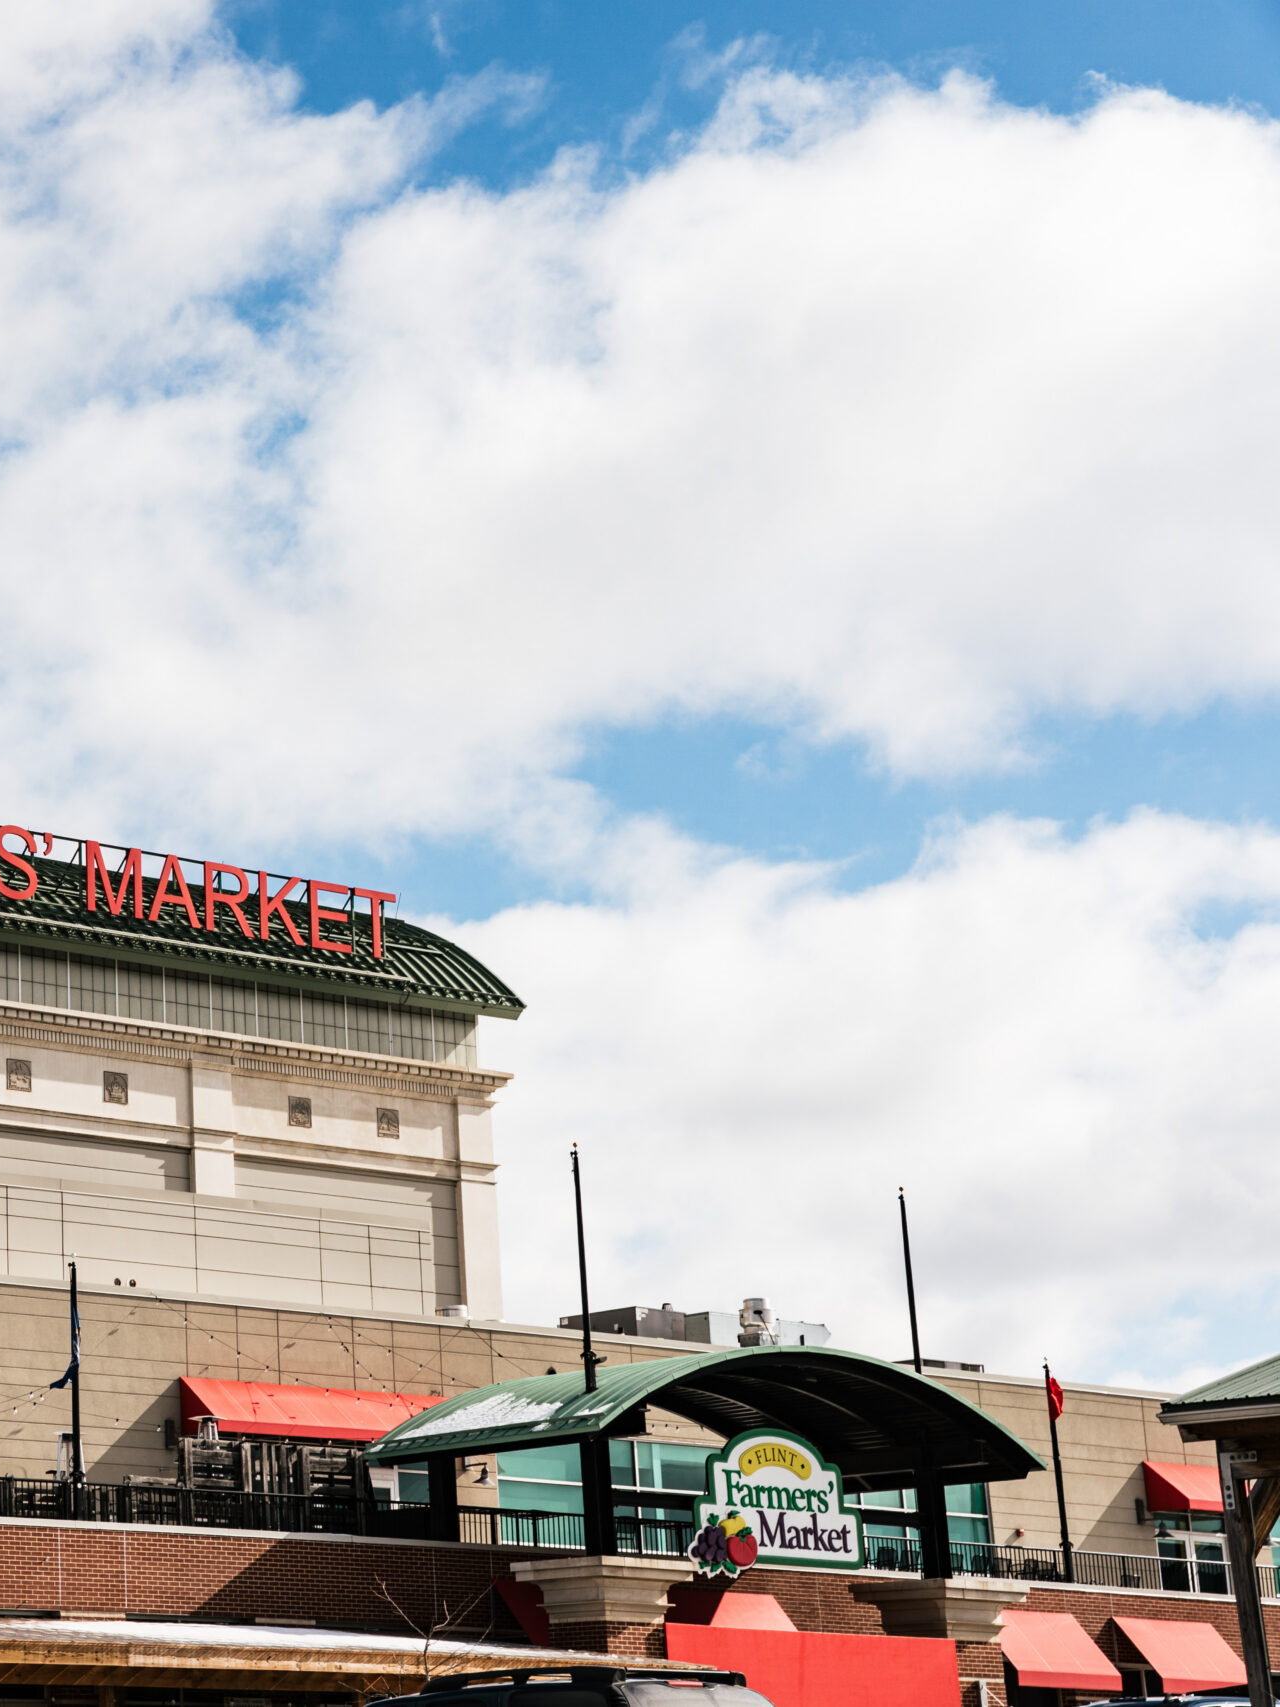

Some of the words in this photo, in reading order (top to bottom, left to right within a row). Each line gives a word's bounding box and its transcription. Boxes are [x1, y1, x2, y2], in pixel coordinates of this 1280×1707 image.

[86, 840, 397, 958] MARKET
[755, 1448, 798, 1467] FLINT
[757, 1510, 852, 1553] Market
